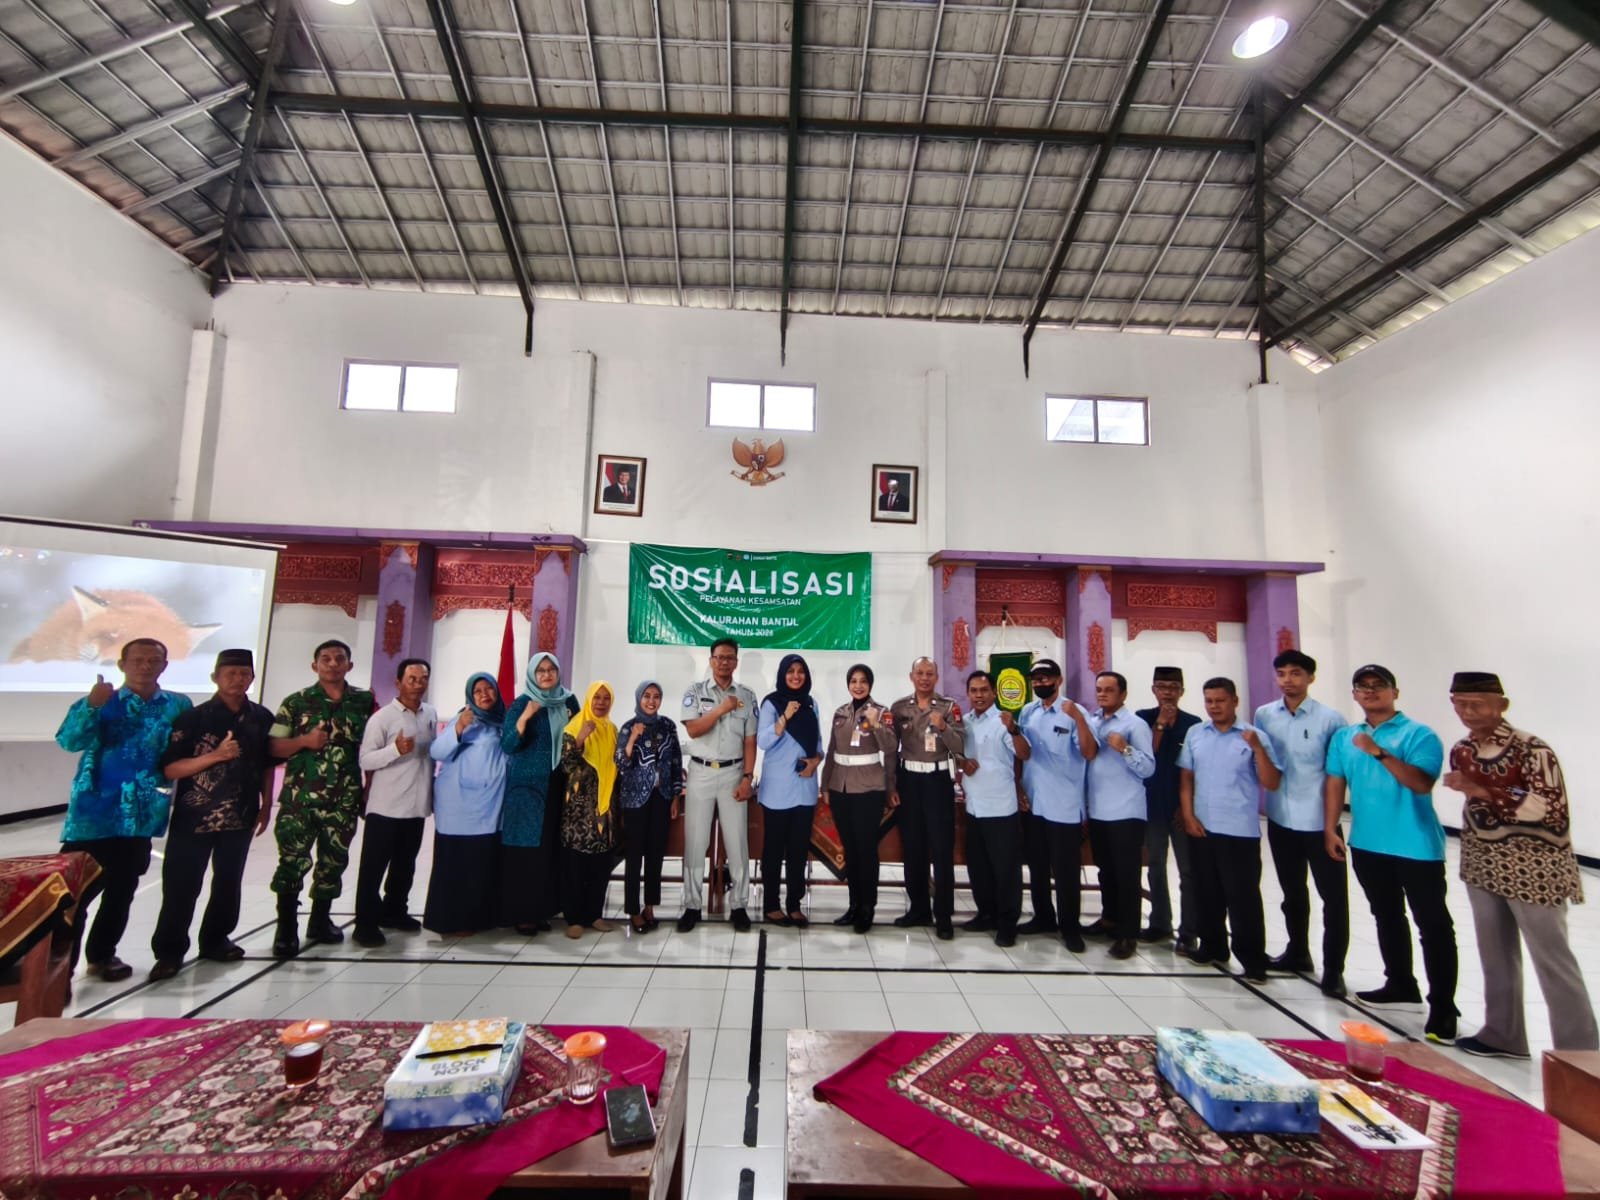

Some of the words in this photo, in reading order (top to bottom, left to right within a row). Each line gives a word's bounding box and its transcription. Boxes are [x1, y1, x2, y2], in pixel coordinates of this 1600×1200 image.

[648, 565, 854, 596] SOSIALISASI
[700, 594, 746, 604] PELAYANAN
[748, 597, 801, 606] KESAMSATAN
[700, 615, 759, 626] KALURAHAN
[762, 617, 799, 626] BANTUL
[726, 627, 754, 637] TAHUN
[431, 1057, 487, 1070] BLOCK
[434, 1064, 481, 1076] NOTE
